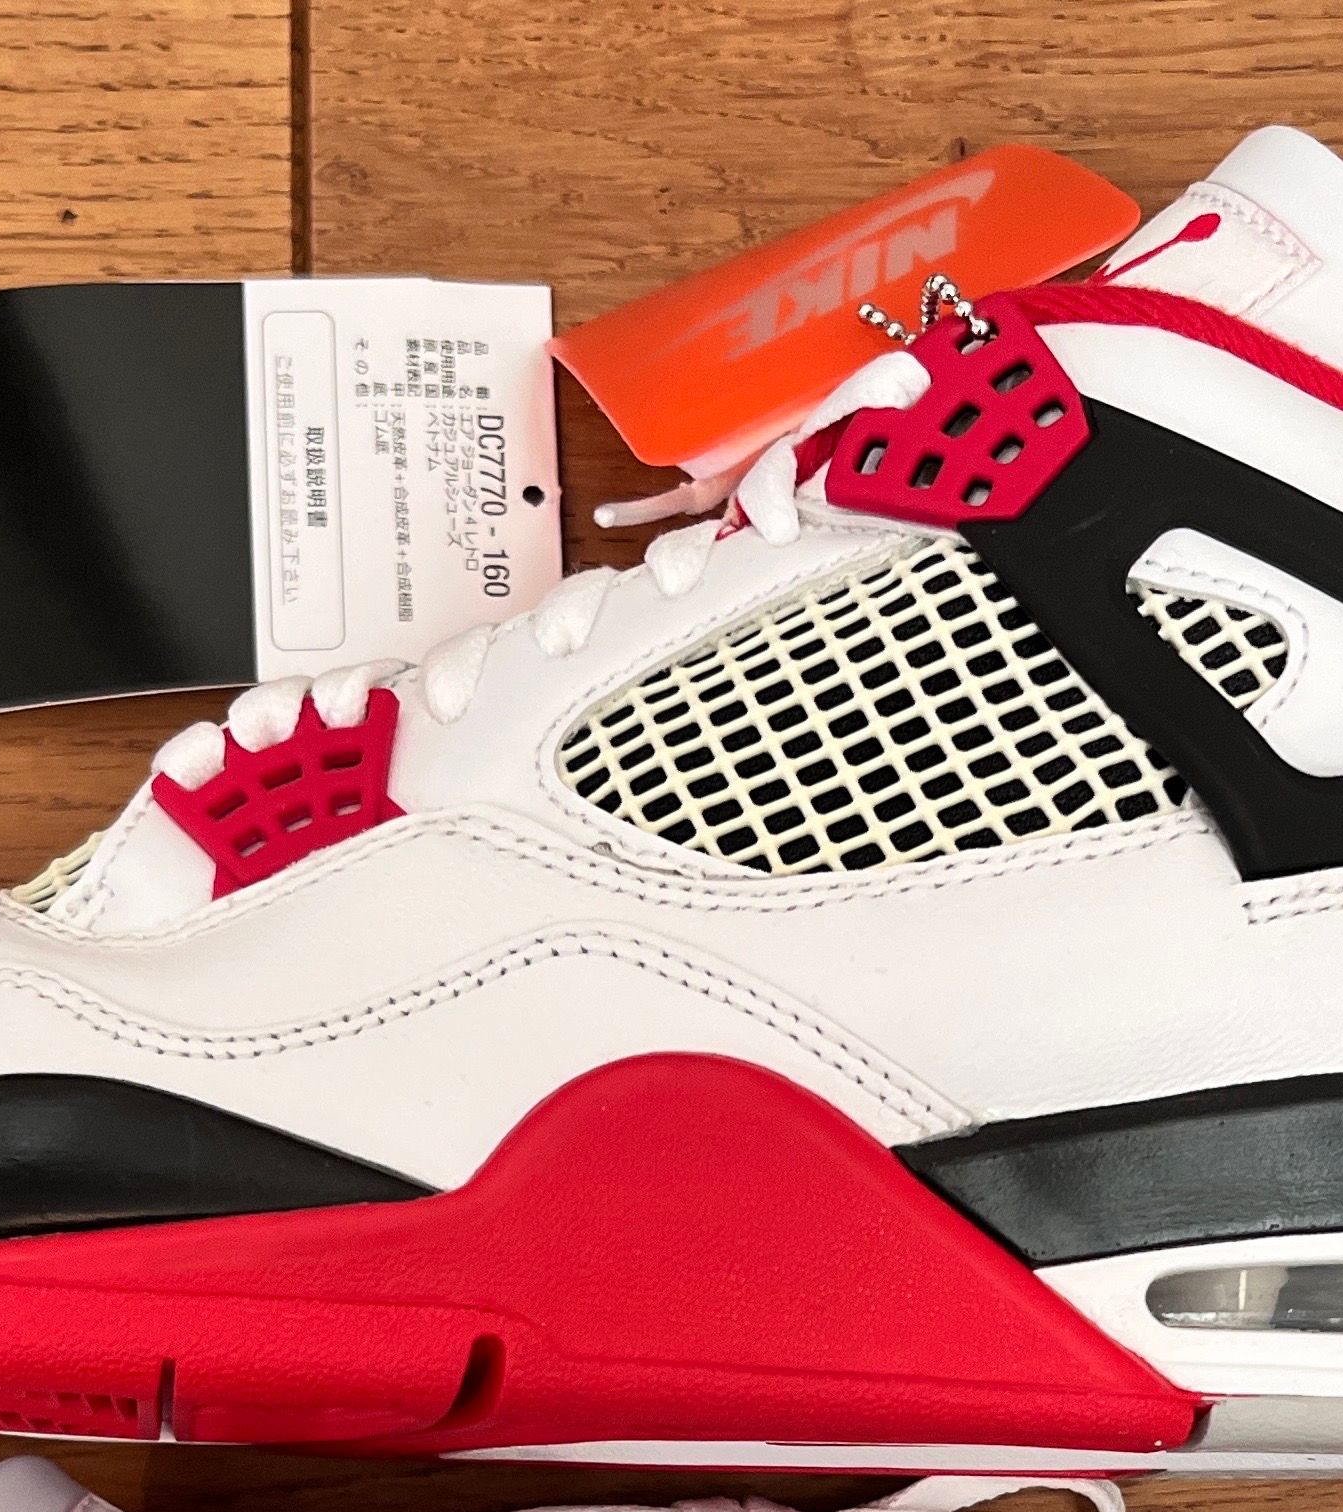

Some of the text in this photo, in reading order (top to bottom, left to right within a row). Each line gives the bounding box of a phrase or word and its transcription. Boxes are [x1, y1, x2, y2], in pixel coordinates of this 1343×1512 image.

[723, 199, 962, 360] NIKE
[306, 427, 328, 527] 取扱説明書
[478, 415, 507, 516] DC7770
[483, 550, 510, 597] 160
